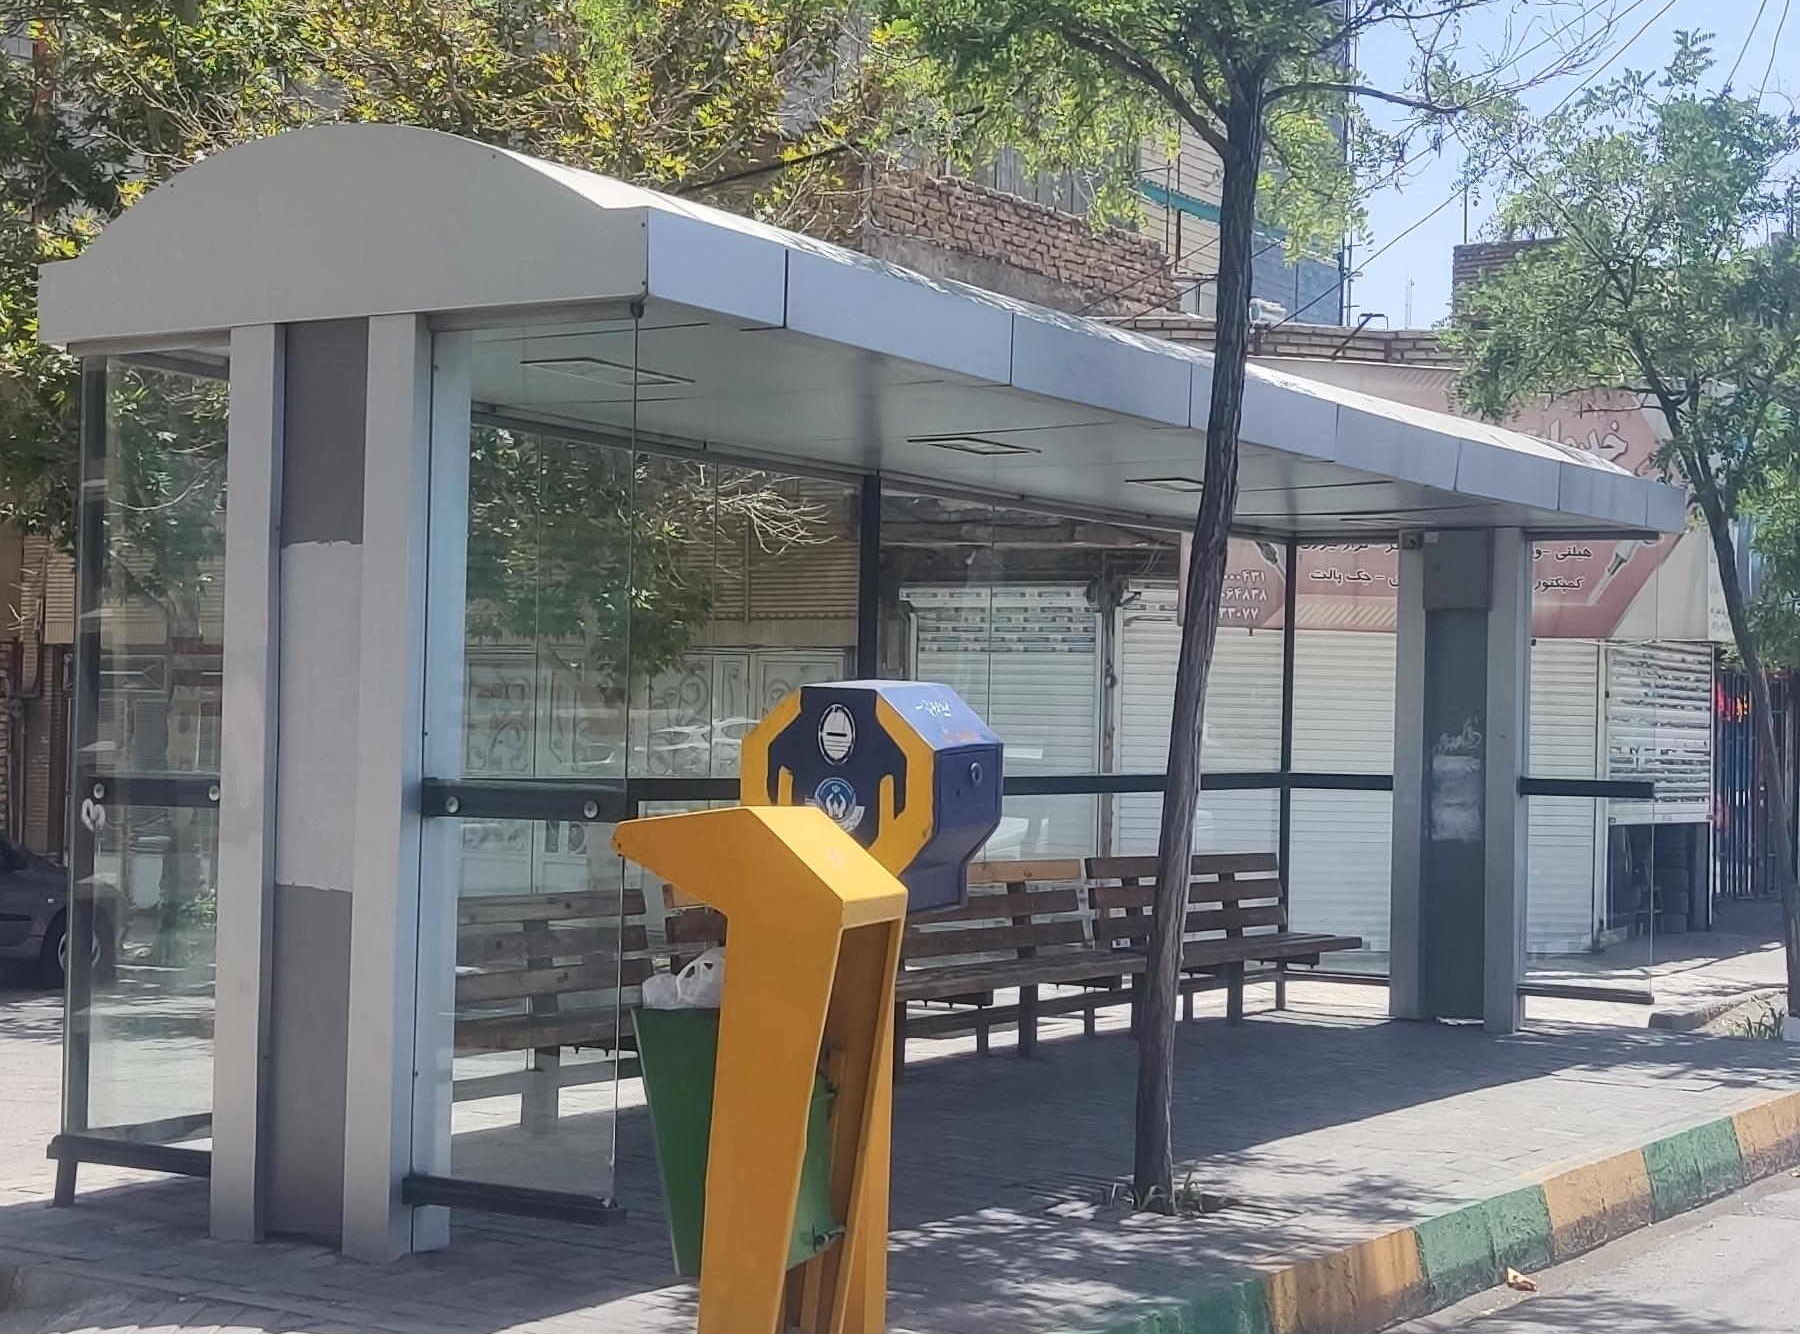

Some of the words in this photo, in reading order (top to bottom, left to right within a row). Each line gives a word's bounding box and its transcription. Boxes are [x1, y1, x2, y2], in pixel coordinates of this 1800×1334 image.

[1555, 545, 1593, 562] هیلتی
[1310, 568, 1343, 586] پالت
[1346, 568, 1372, 584] جک
